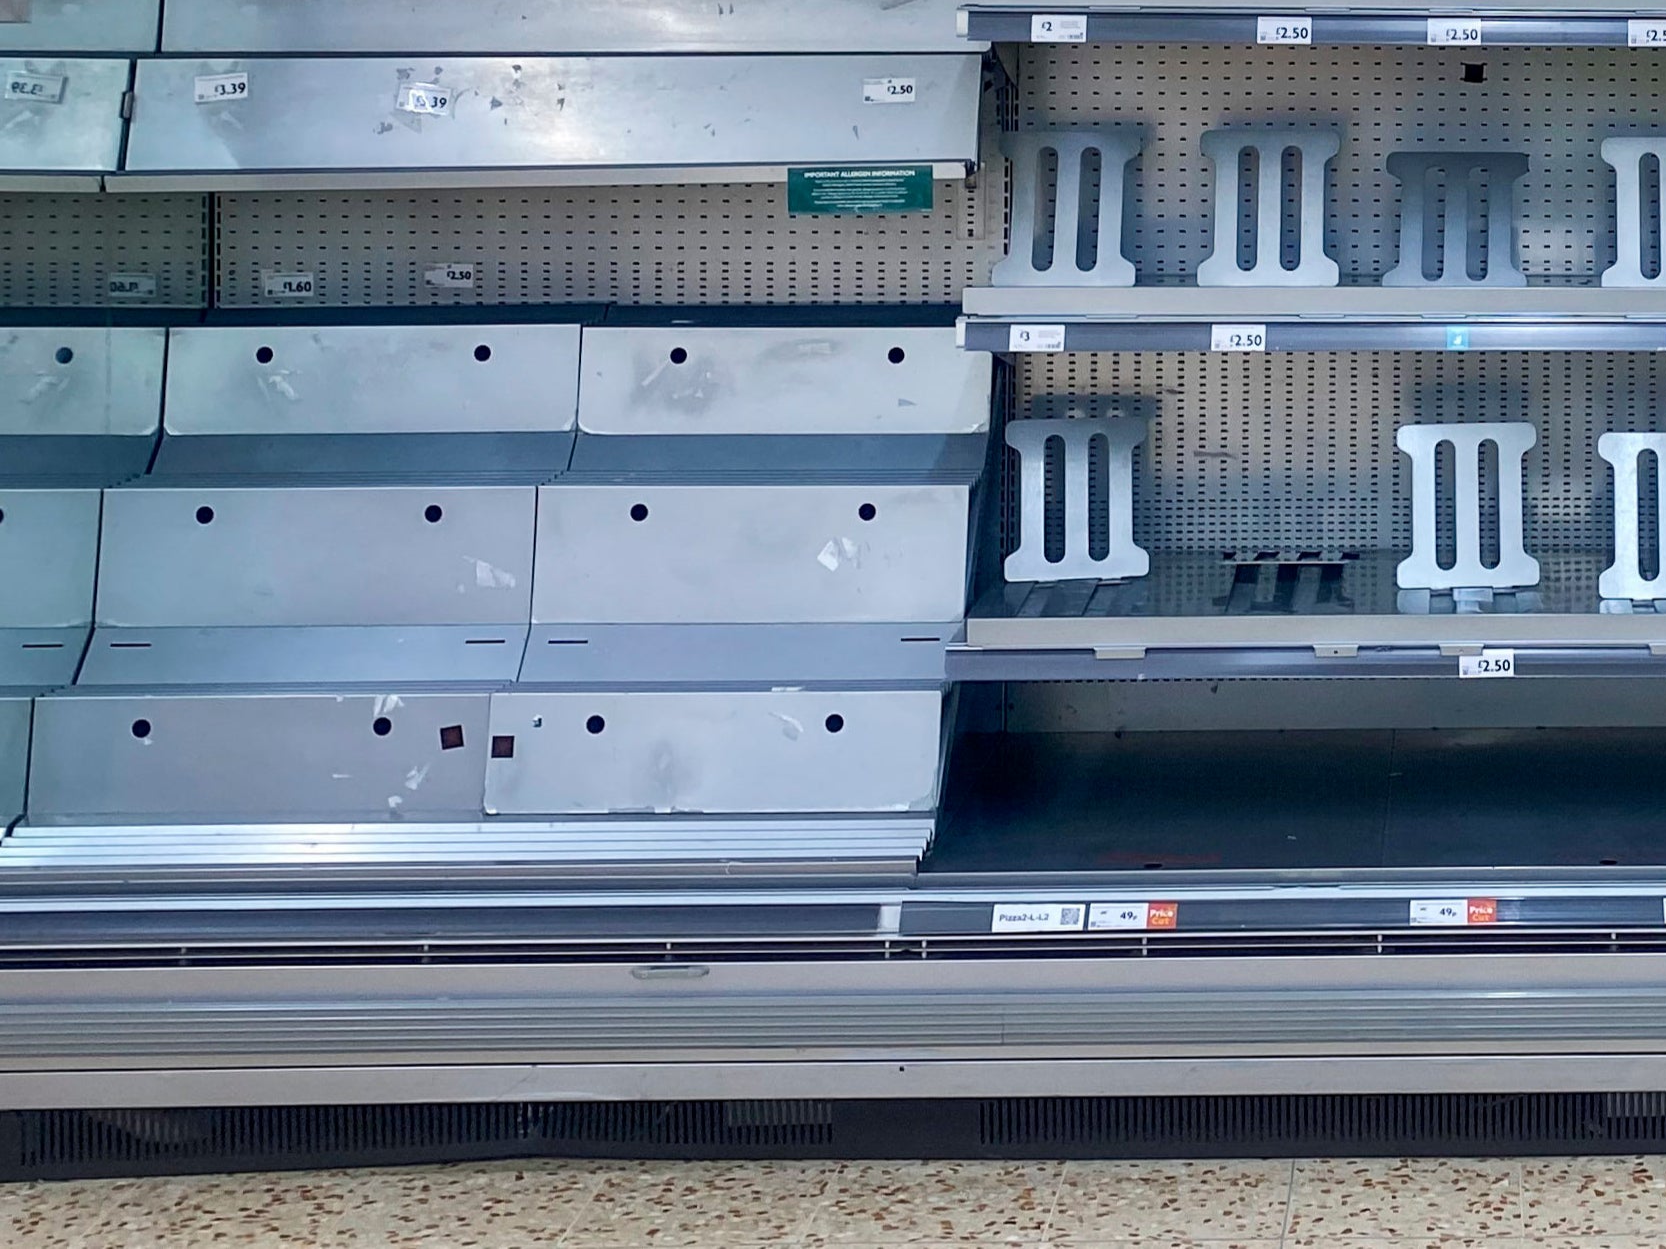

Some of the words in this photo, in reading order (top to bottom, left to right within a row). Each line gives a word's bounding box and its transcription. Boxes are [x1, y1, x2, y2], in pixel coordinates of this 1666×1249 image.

[1041, 21, 1053, 33] £2
[1275, 26, 1309, 41] £2.50
[1446, 28, 1479, 42] £2.50
[1229, 334, 1262, 347] £2.50
[1478, 658, 1511, 672] £2.50
